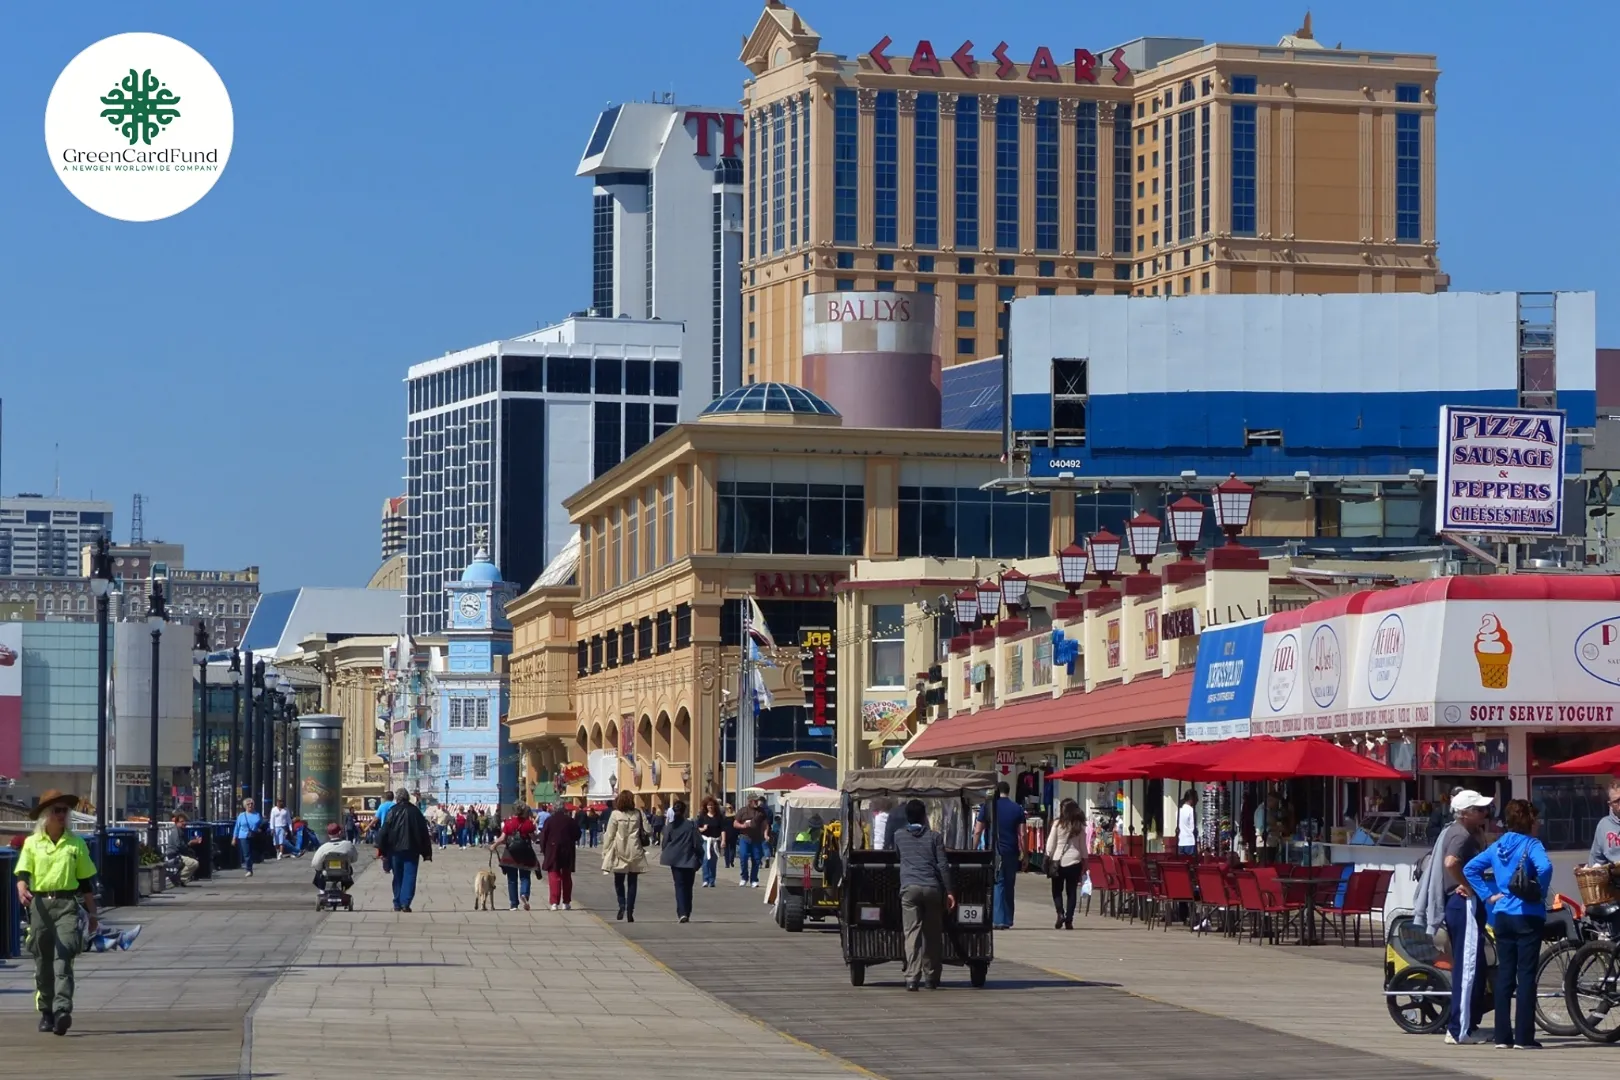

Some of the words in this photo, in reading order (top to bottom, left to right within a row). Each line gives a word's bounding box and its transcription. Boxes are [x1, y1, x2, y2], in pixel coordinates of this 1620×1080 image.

[869, 35, 1130, 86] CAESARS
[828, 297, 910, 321] BALLY'S
[1452, 414, 1557, 446] PIZZA
[1049, 459, 1081, 468] 040492
[1452, 446, 1554, 468] SAUSAGE
[1498, 470, 1508, 479] &
[1452, 480, 1552, 501] PEPPERS
[1451, 506, 1554, 525] CHEESESTEAKS
[1470, 705, 1505, 721] SOFT
[1509, 705, 1554, 721] SERVE
[1558, 705, 1614, 721] YOGURT
[997, 751, 1014, 763] ATM
[1065, 750, 1084, 758] ATM
[963, 910, 978, 919] 39
